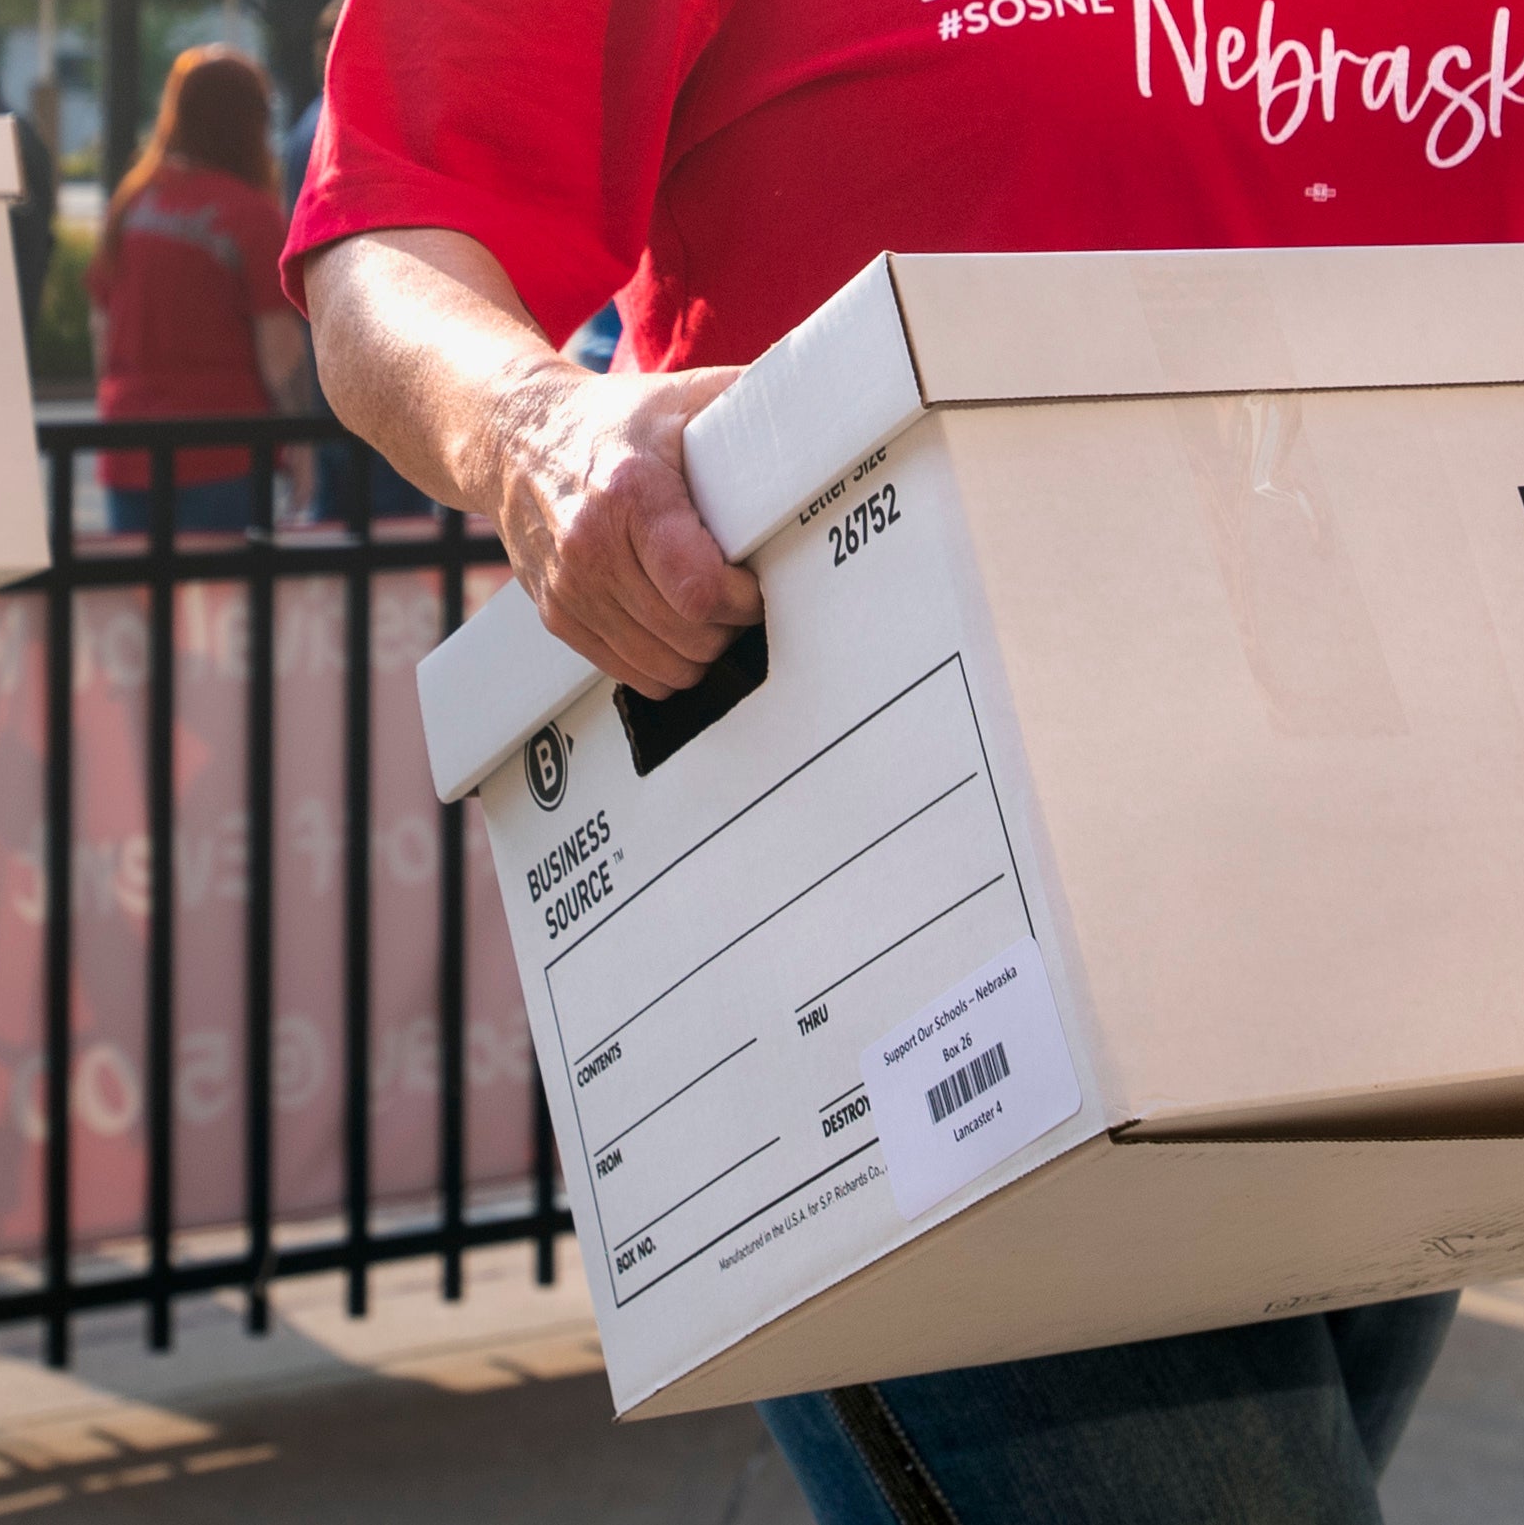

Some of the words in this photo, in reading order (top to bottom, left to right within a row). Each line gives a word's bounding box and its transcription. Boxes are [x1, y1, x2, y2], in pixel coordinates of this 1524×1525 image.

[828, 483, 901, 568] 26752
[527, 809, 611, 903] BUSINESS
[545, 860, 613, 940] SOURCE
[797, 1003, 829, 1037] THRU
[883, 1034, 918, 1067] Support
[917, 1024, 934, 1044] Our
[934, 998, 969, 1032] Schools
[975, 965, 1018, 1002] Nebraska
[577, 1041, 622, 1088] CONTENTS
[942, 1043, 960, 1063] Box
[960, 1032, 973, 1052] 26
[953, 1110, 996, 1143] Lancaster
[995, 1099, 1004, 1114] 4
[595, 1147, 624, 1179] FROM
[719, 1233, 764, 1272] Manufactured
[764, 1230, 773, 1244] in
[771, 1222, 785, 1240] the
[784, 1208, 808, 1231] U.S.A.
[807, 1202, 819, 1217] for
[819, 1190, 835, 1211] S.P.
[834, 1172, 869, 1201] Richards
[615, 1245, 638, 1275] BOX
[637, 1235, 657, 1262] NO.
